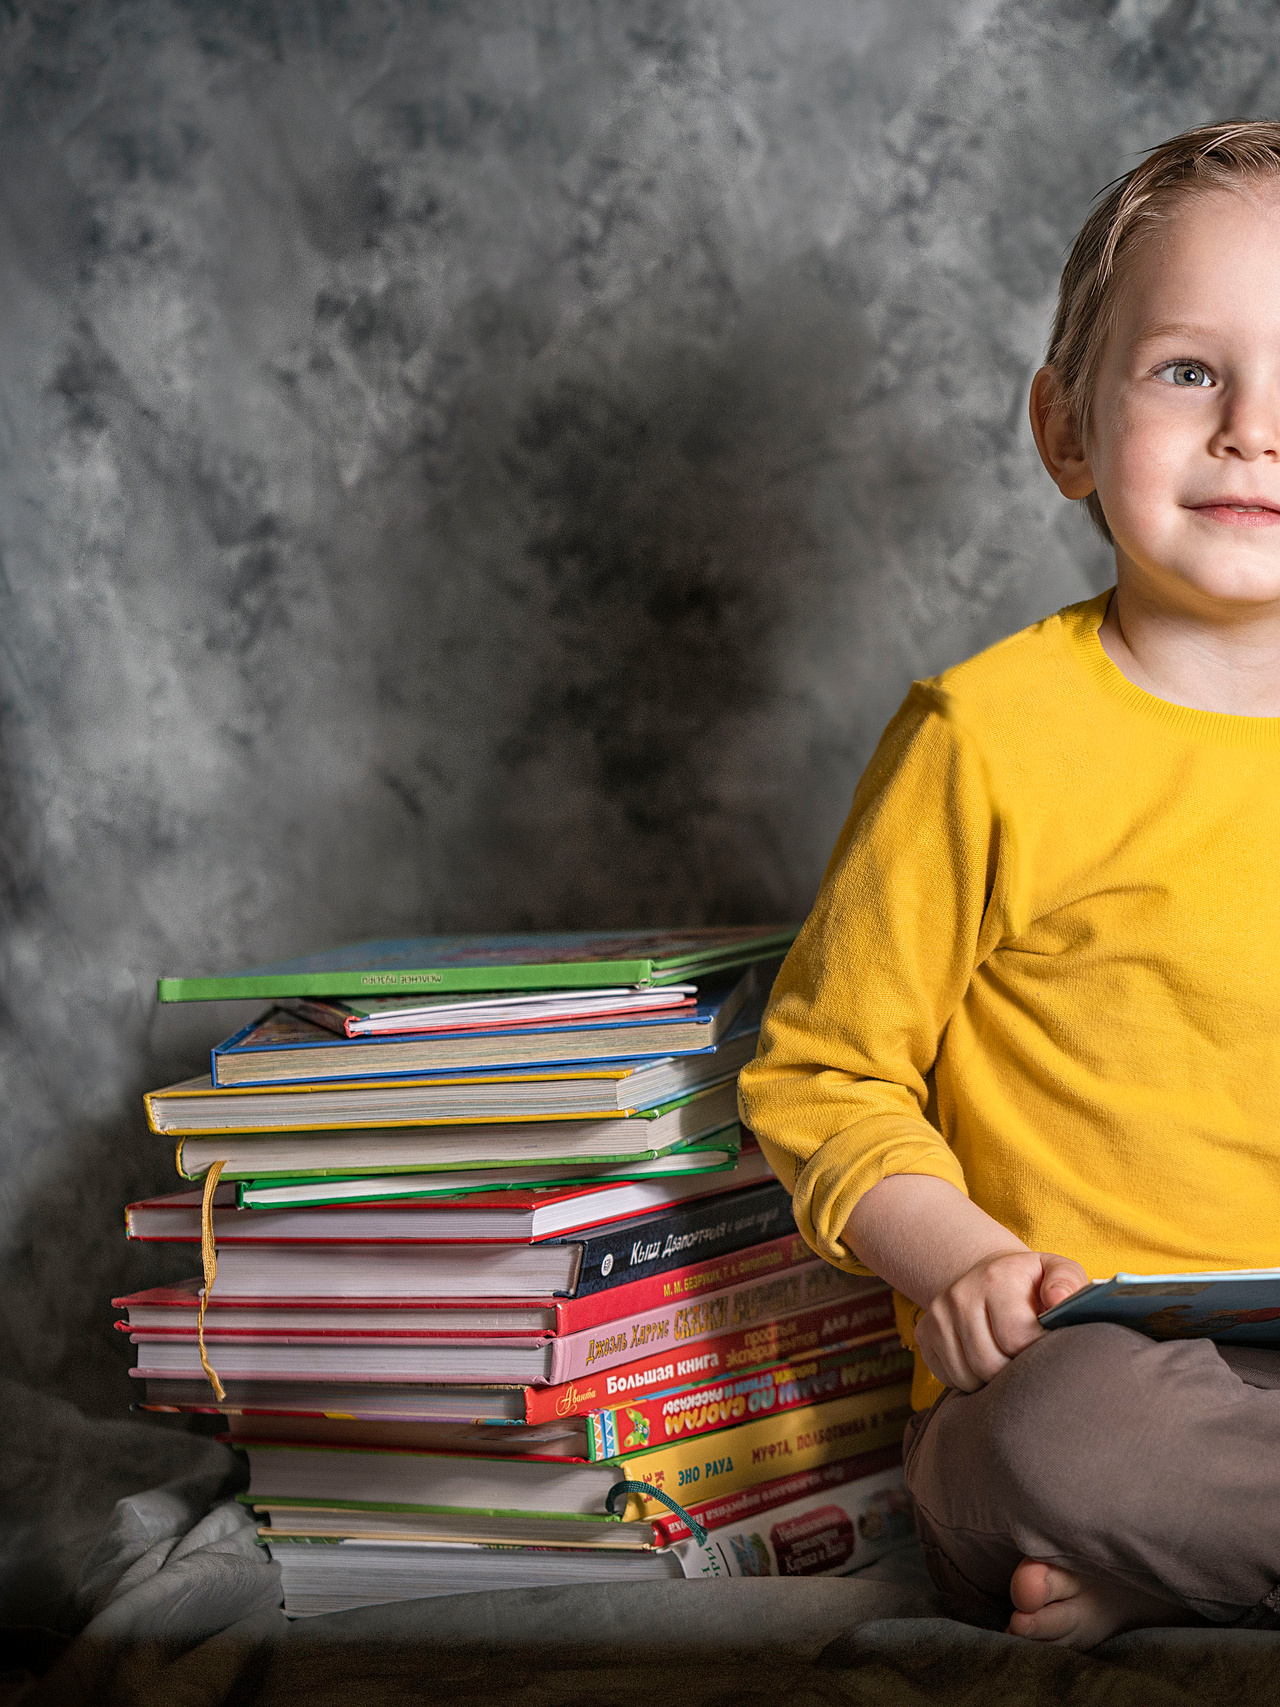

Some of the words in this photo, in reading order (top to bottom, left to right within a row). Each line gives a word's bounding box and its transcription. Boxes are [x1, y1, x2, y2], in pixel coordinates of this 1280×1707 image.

[629, 1240, 661, 1266] Кыш,
[663, 1284, 673, 1297] М.
[674, 1281, 684, 1294] М.
[673, 1295, 729, 1341] СКАЗКИ
[606, 1363, 675, 1395] Большая
[676, 1352, 720, 1377] книга
[662, 1387, 723, 1416] РАССКАЗЫ
[724, 1384, 735, 1398] И
[748, 1387, 776, 1412] ПО
[664, 1395, 746, 1436] СЛОГАМ
[678, 1466, 700, 1486] ЭНО
[705, 1456, 734, 1479] РАУД
[751, 1441, 793, 1465] МУФТА,
